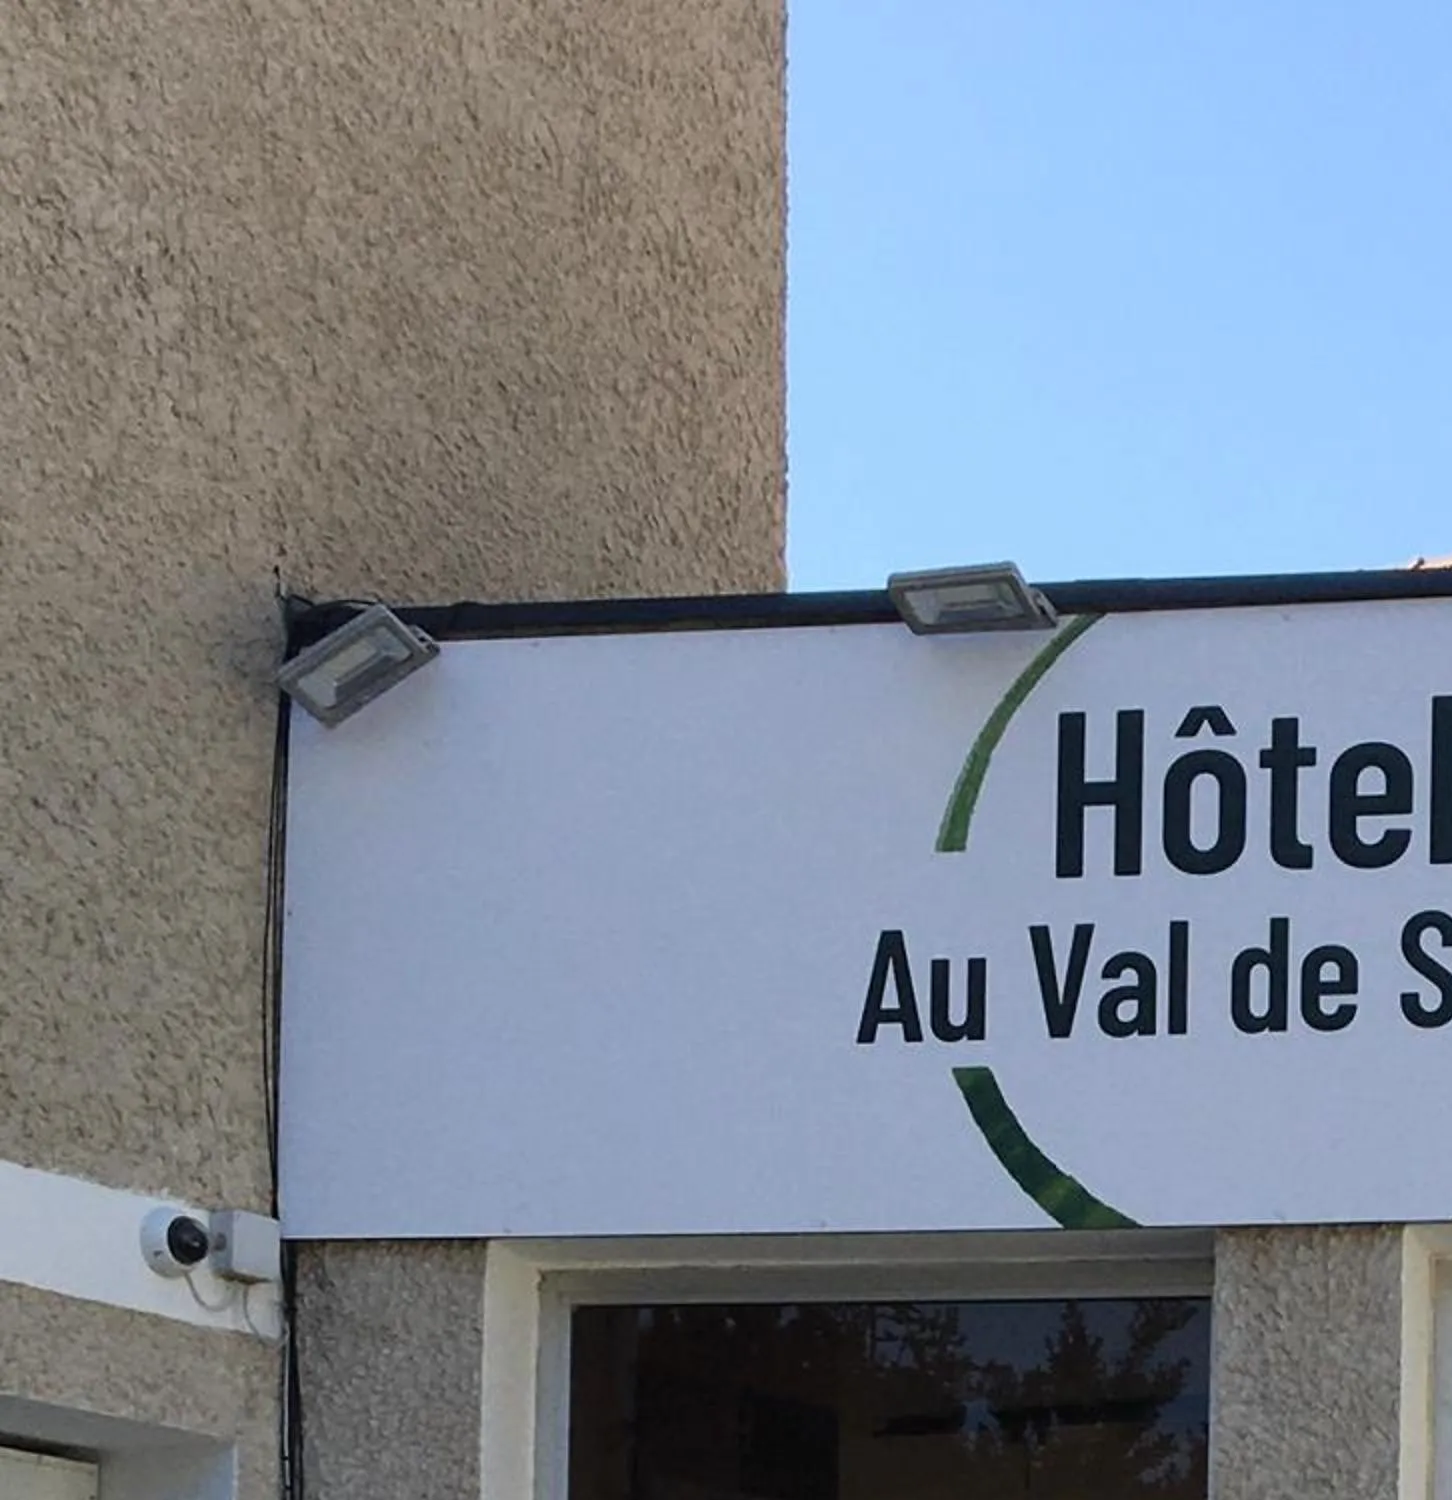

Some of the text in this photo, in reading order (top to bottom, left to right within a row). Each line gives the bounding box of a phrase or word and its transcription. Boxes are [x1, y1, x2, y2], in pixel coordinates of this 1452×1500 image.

[856, 929, 987, 1045] Au
[1028, 920, 1190, 1039] Val
[1230, 916, 1359, 1034] de
